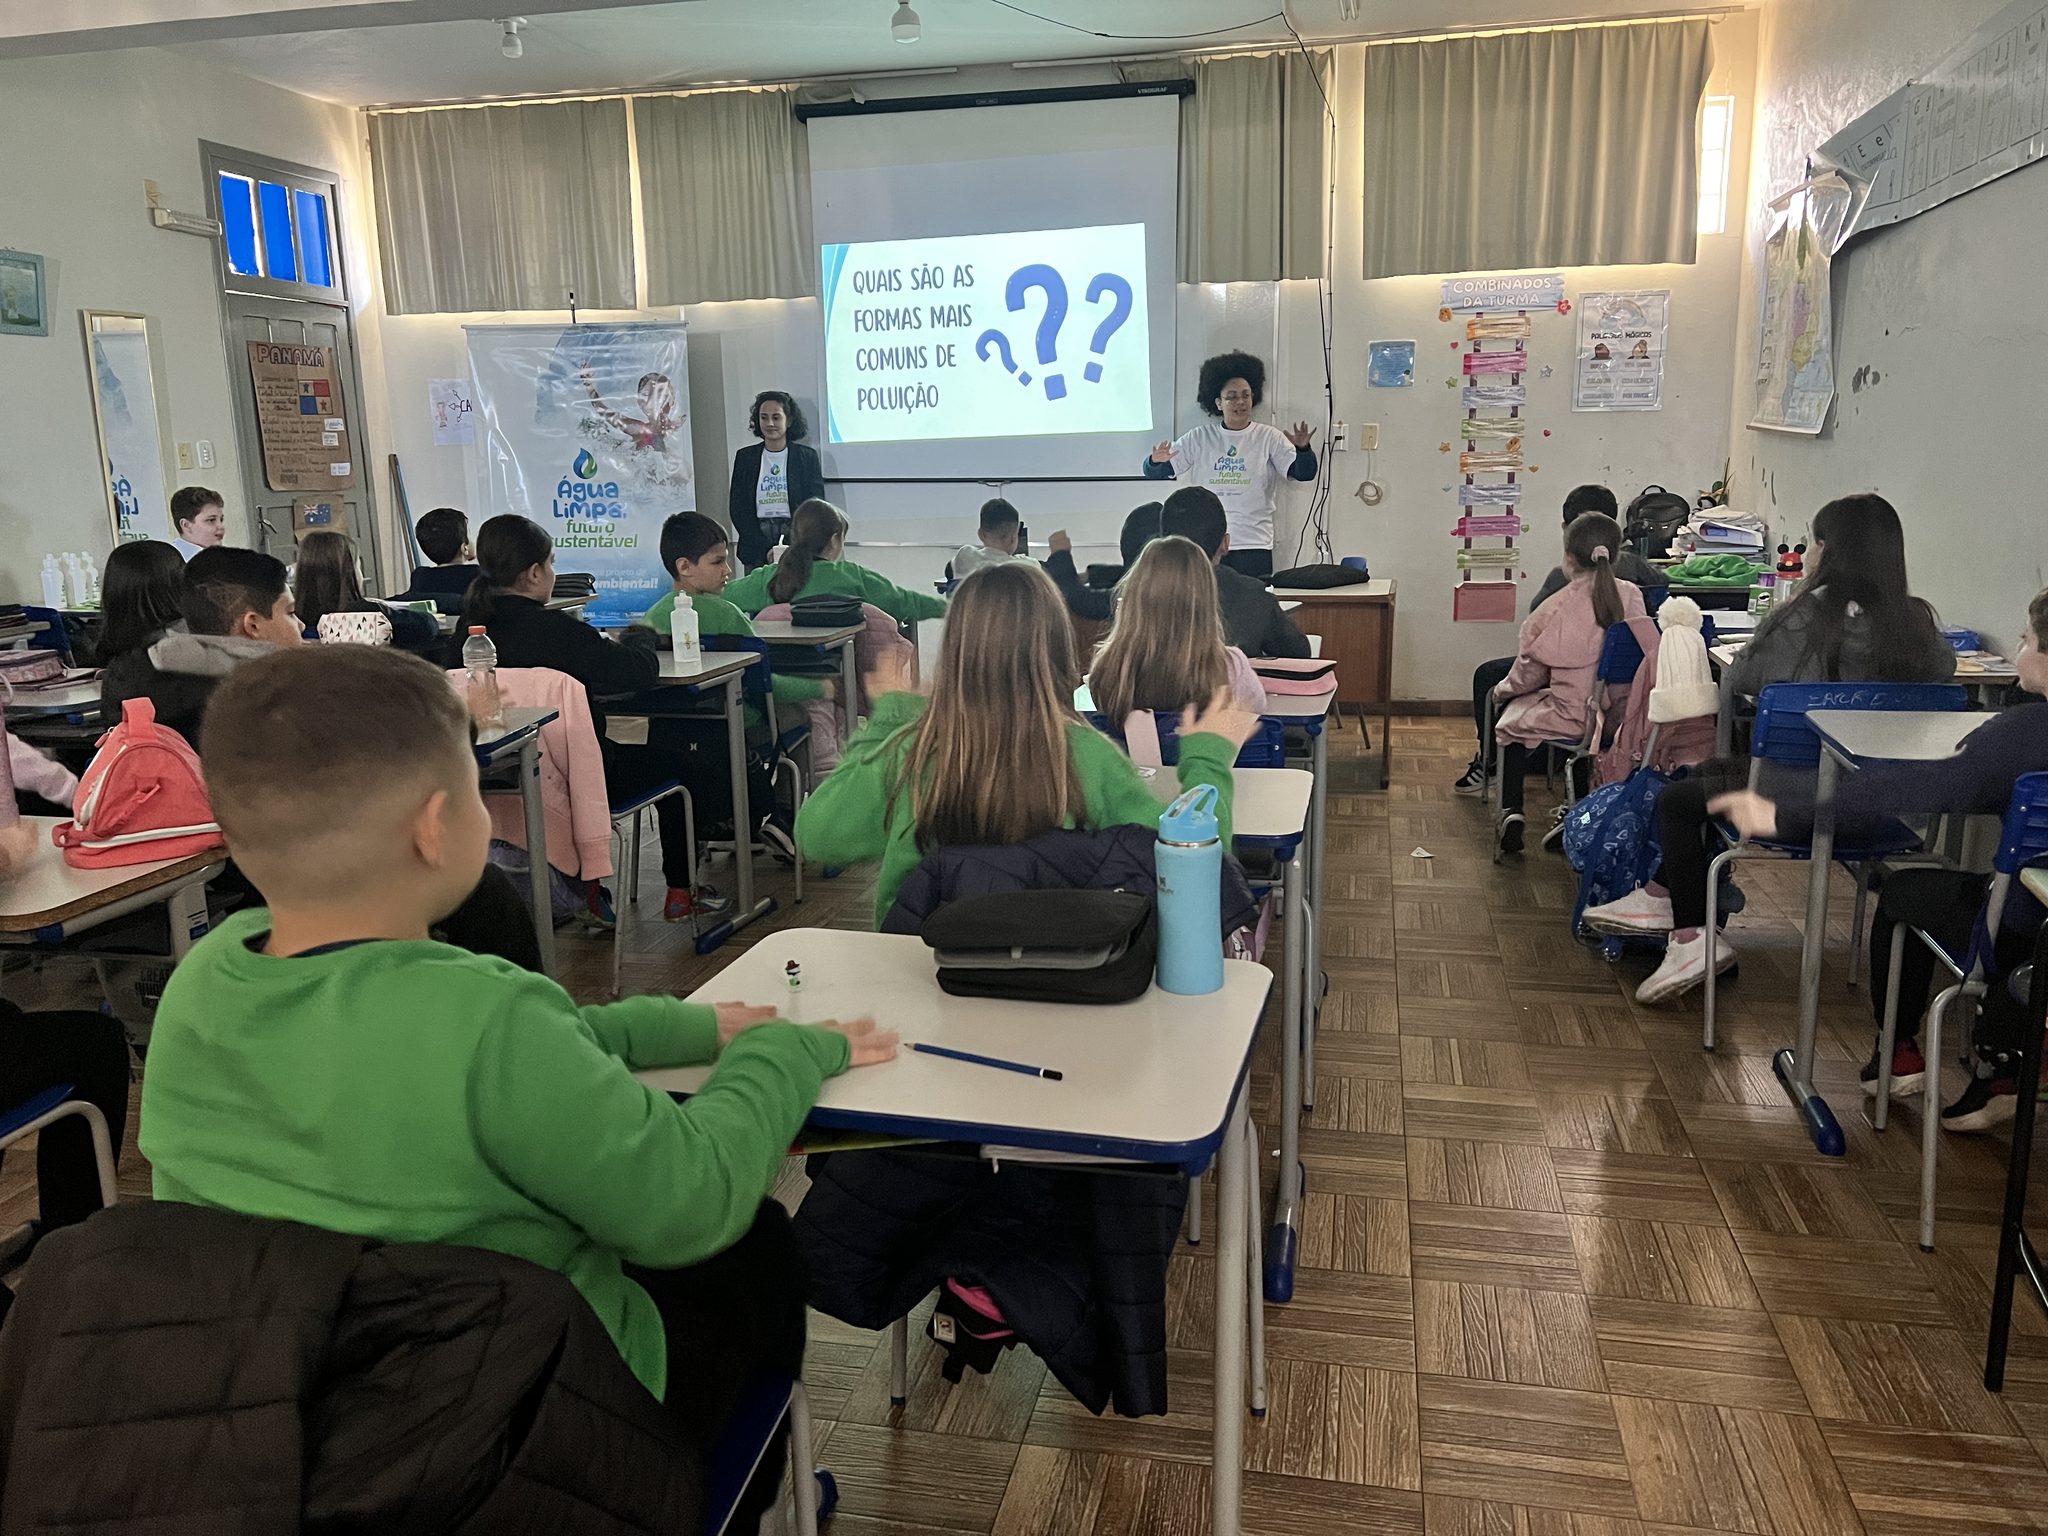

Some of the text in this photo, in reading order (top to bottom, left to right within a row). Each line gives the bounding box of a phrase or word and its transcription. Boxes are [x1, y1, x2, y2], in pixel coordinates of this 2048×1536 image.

[853, 263, 974, 294] QUAIS SÃO AS
[1453, 277, 1552, 293] COMBINADOS
[1463, 294, 1540, 308] DA TURMA
[854, 304, 973, 332] FORMAS MAIS
[257, 344, 324, 367] PANAMÁ
[856, 344, 957, 371] COMUNS DE
[857, 382, 939, 414] POLUIÇÃO
[557, 475, 619, 502] Água
[1208, 477, 1252, 485] sustentável
[566, 519, 615, 534] futuro
[551, 534, 638, 548] ustentável
